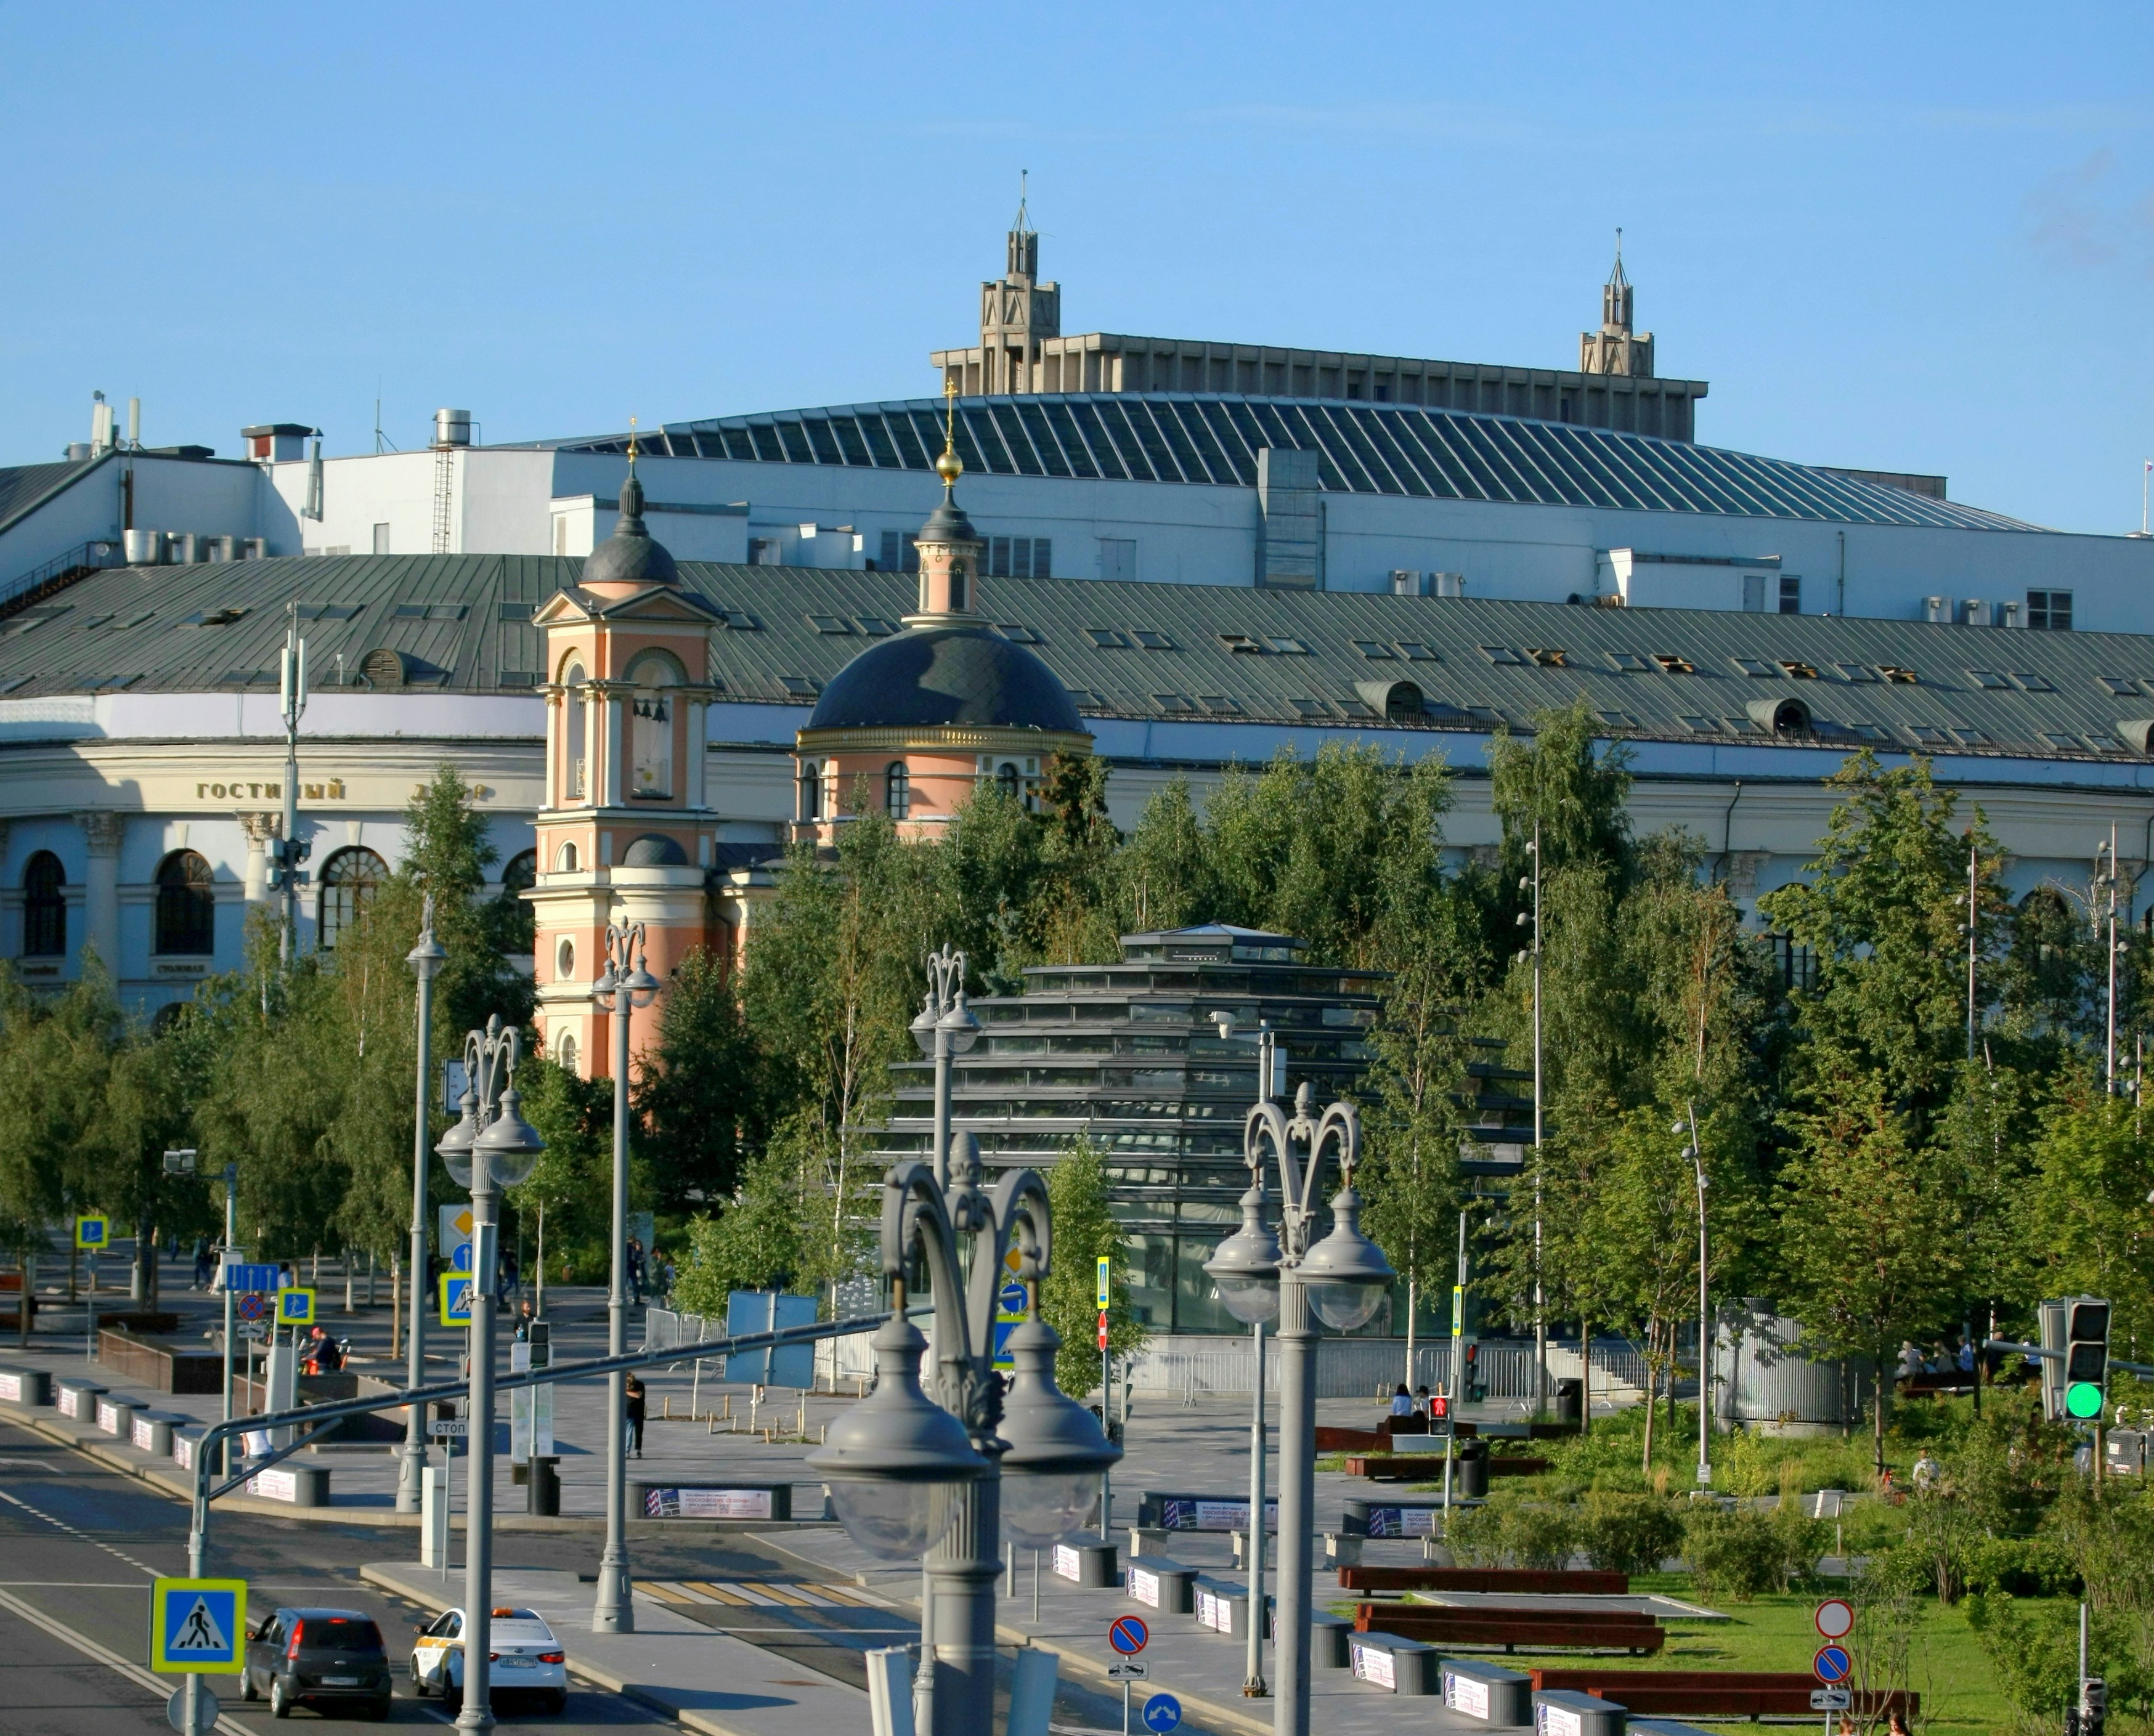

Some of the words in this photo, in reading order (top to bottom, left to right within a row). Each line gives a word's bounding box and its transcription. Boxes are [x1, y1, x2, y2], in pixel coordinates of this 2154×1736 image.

[196, 777, 344, 799] ГОСТИЫЙ
[410, 784, 487, 800] ДР
[436, 1424, 465, 1434] СТОП
